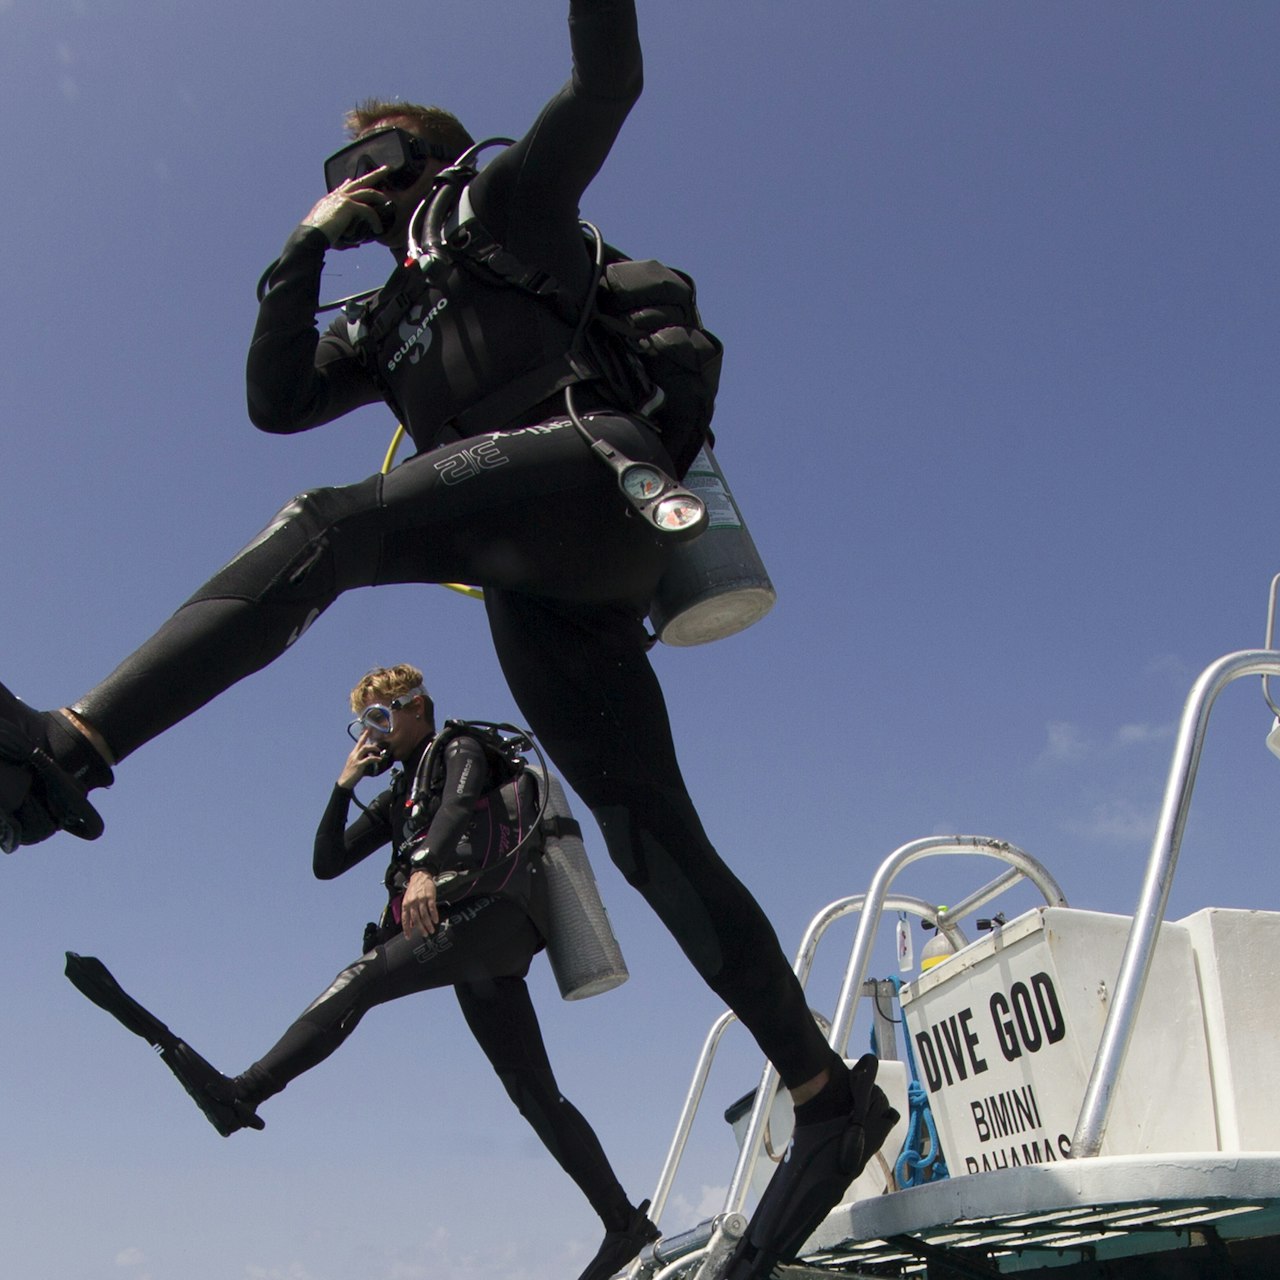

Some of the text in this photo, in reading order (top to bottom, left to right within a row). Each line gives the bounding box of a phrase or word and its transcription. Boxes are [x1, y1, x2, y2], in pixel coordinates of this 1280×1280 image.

[387, 298, 448, 371] SCUBAPRO
[915, 971, 1065, 1093] DIVE GOD
[970, 1085, 1042, 1142] BIMINI
